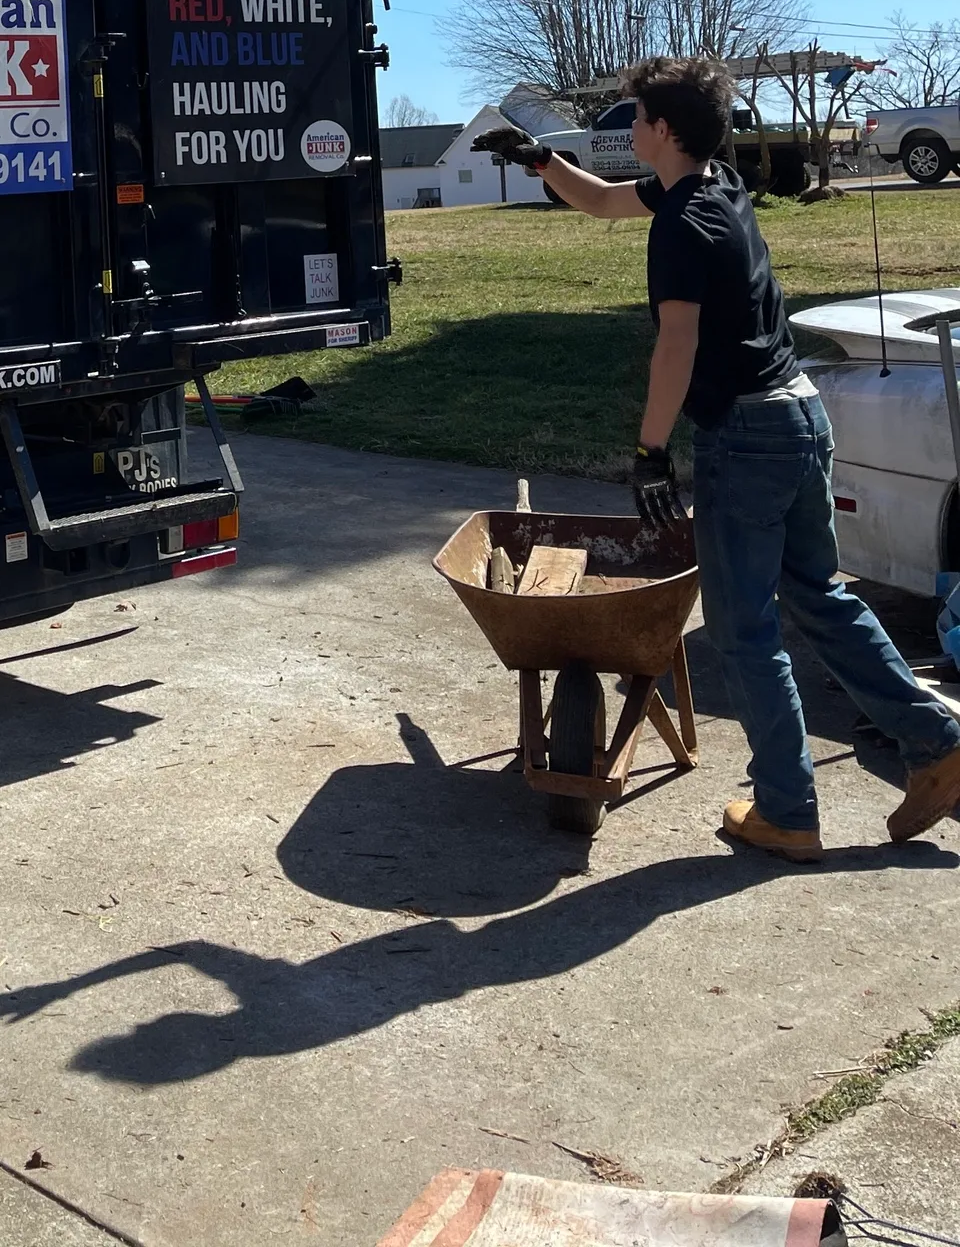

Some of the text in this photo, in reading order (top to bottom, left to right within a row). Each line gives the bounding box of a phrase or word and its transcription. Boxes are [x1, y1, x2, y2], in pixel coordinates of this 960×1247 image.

[171, 31, 305, 66] AND BLUE
[172, 81, 287, 116] HAULING
[10, 112, 58, 138] Co.
[306, 133, 345, 142] American
[175, 128, 285, 166] FOR YOU
[311, 142, 341, 153] JUNK
[309, 272, 332, 284] TALK
[310, 287, 334, 299] JUNK
[327, 326, 357, 337] MASON
